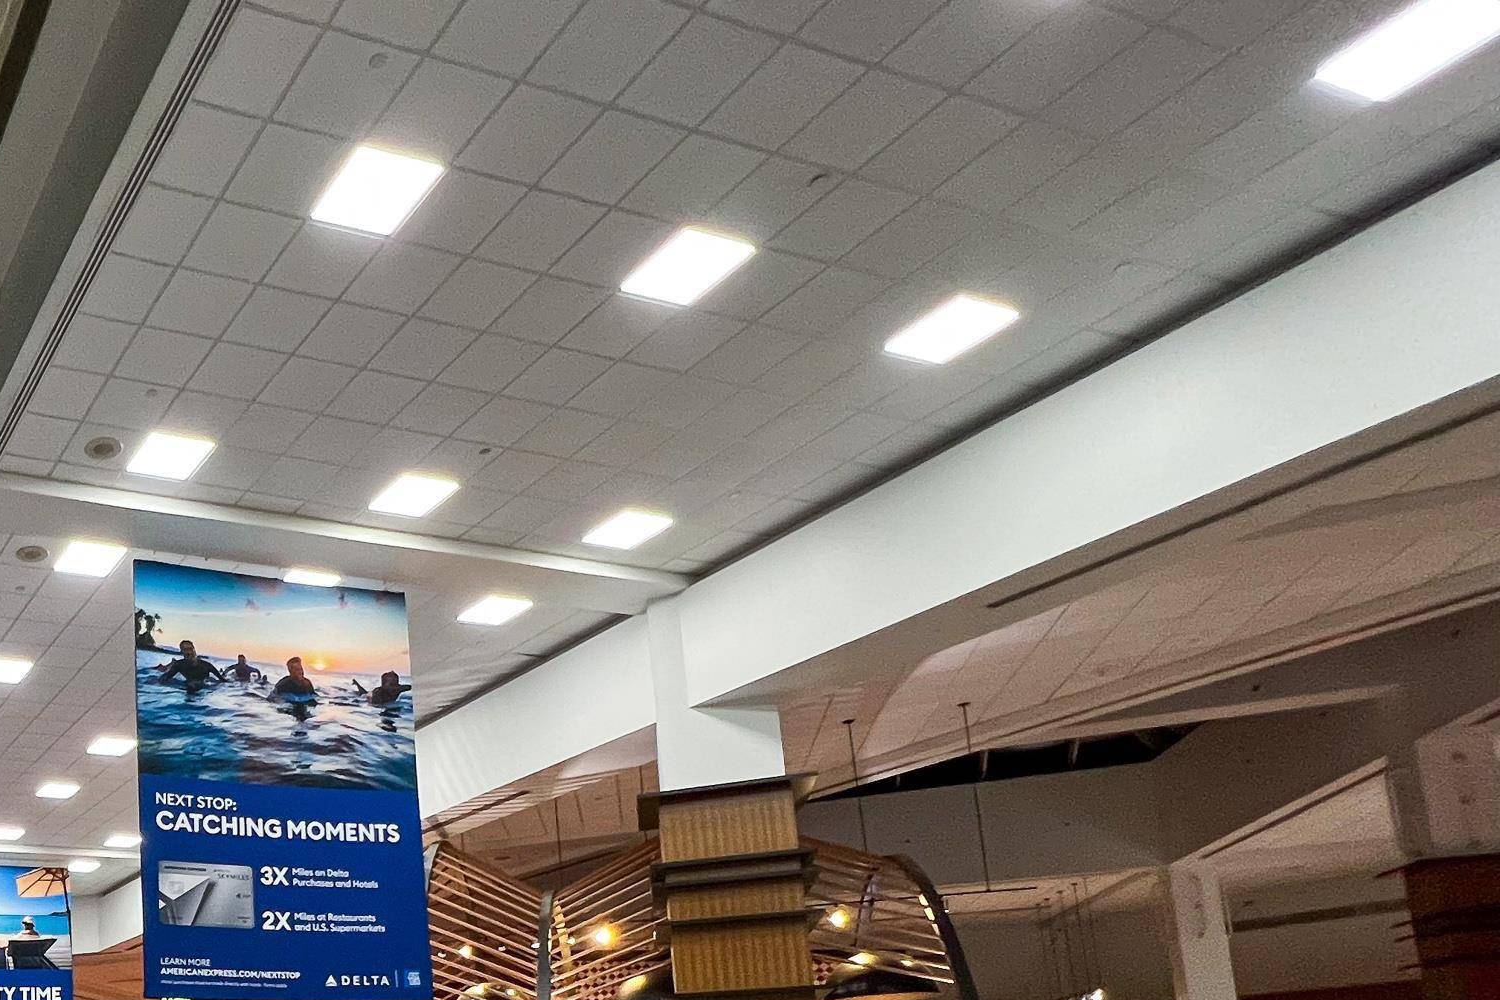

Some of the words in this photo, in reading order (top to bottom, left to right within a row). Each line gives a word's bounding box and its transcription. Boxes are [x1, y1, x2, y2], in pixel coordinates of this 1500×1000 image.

[155, 792, 194, 808] NEXT
[196, 796, 237, 811] STOP:
[155, 811, 282, 838] CATCHING
[287, 821, 401, 843] MOMENTS
[260, 866, 289, 886] 3X
[292, 868, 313, 876] Miles
[327, 869, 349, 878] Delta
[292, 879, 334, 888] Purchases
[335, 880, 351, 888] and
[353, 880, 379, 889] Hotels
[262, 911, 292, 931] 2X
[294, 913, 315, 921] Miles
[328, 913, 376, 922] Restaurants
[312, 924, 329, 932] U.S.
[330, 924, 386, 933] Supermarkets
[160, 957, 187, 965] LEARN
[188, 958, 210, 967] MORE
[160, 967, 301, 979] AMERICANEXPRESS.COM/NEXTSTOP
[341, 975, 390, 986] DELTA
